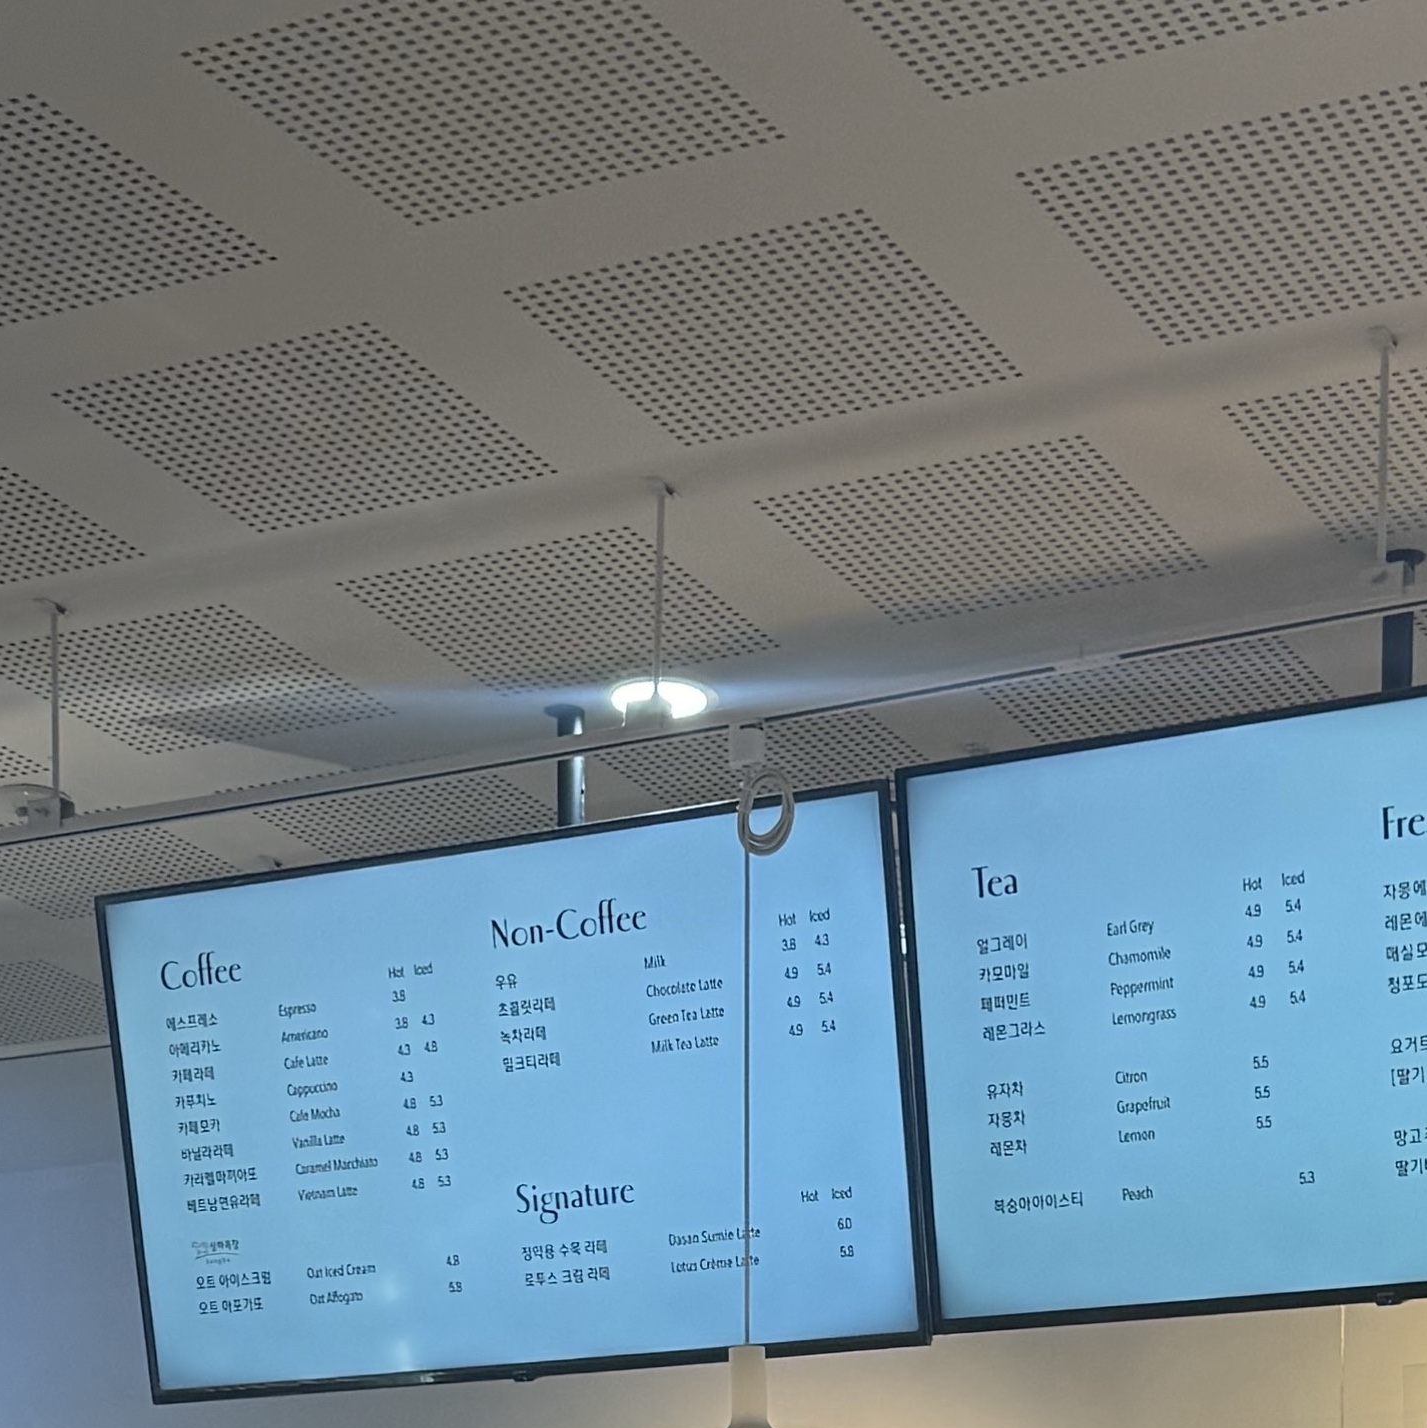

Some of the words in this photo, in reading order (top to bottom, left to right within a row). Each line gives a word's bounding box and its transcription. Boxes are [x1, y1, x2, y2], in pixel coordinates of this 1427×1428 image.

[971, 866, 1018, 898] Tea
[1243, 877, 1262, 892] Hot
[1282, 870, 1305, 886] Iced
[779, 913, 796, 926] Hot
[809, 908, 830, 922] Iced
[1245, 904, 1261, 917] 4.9
[1286, 898, 1301, 912] 5.4
[491, 898, 647, 949] Non-Coffee
[1107, 921, 1127, 936] Earl
[1130, 920, 1154, 935] Grey
[1247, 934, 1263, 948] 4.9
[1287, 929, 1302, 943] 5.4
[1108, 946, 1171, 966] Chamomile
[161, 951, 242, 990] Coffee
[1248, 965, 1264, 978] 4.9
[1289, 959, 1304, 974] 5.4
[1111, 977, 1173, 998] Peppermint
[1250, 995, 1266, 1009] 4.9
[1290, 990, 1306, 1004] 5.4
[1112, 1009, 1176, 1025] Lemongrass
[1253, 1055, 1269, 1069] 5.5
[1115, 1071, 1147, 1084] Citron
[1255, 1086, 1270, 1099] 5.5
[1117, 1096, 1170, 1115] Grapefruit
[1256, 1116, 1272, 1129] 5.5
[1119, 1130, 1155, 1143] Lemon
[1299, 1171, 1315, 1184] 5.3
[1122, 1186, 1153, 1201] Peach
[516, 1184, 634, 1224] Signature
